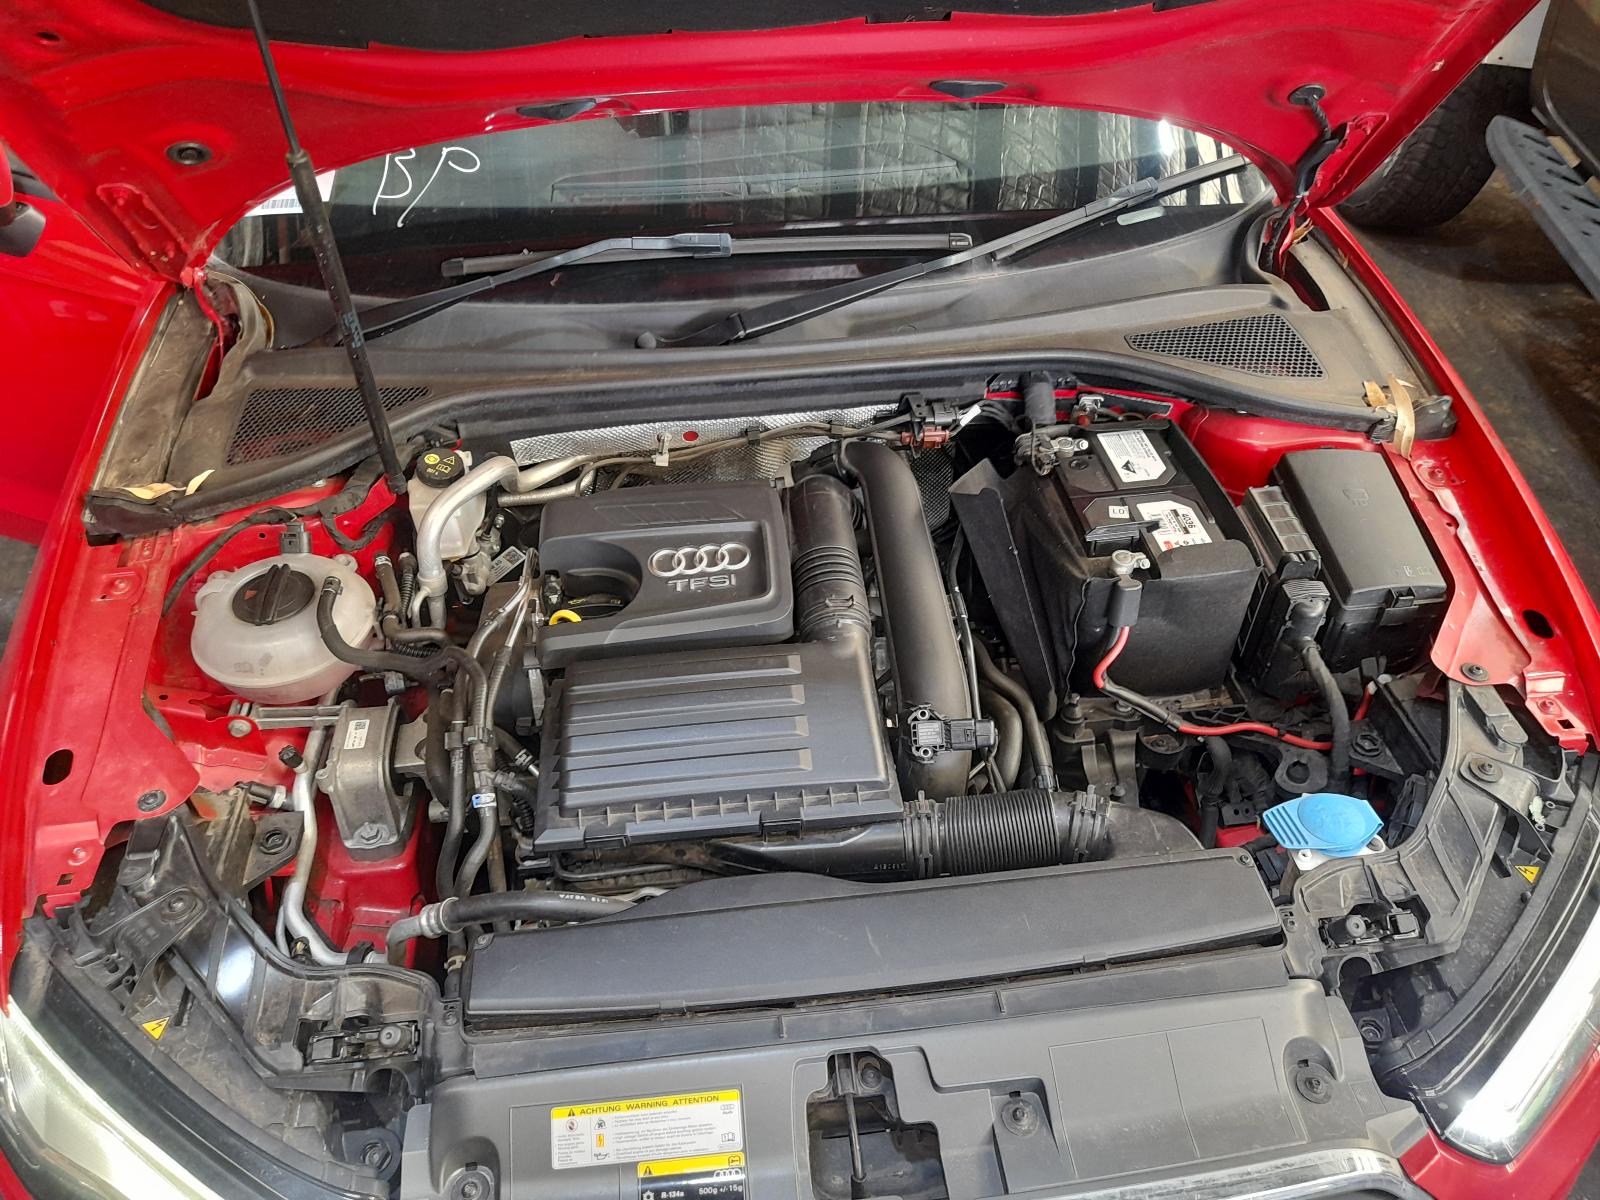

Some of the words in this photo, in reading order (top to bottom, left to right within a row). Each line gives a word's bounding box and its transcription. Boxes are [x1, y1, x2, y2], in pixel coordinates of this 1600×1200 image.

[667, 574, 737, 592] TFSI
[580, 1104, 621, 1116] ACHTUNG
[626, 1101, 668, 1111] WARNING
[673, 1095, 720, 1107] ATTENTION
[660, 1190, 685, 1199] R-134a
[698, 1186, 718, 1196] 500g
